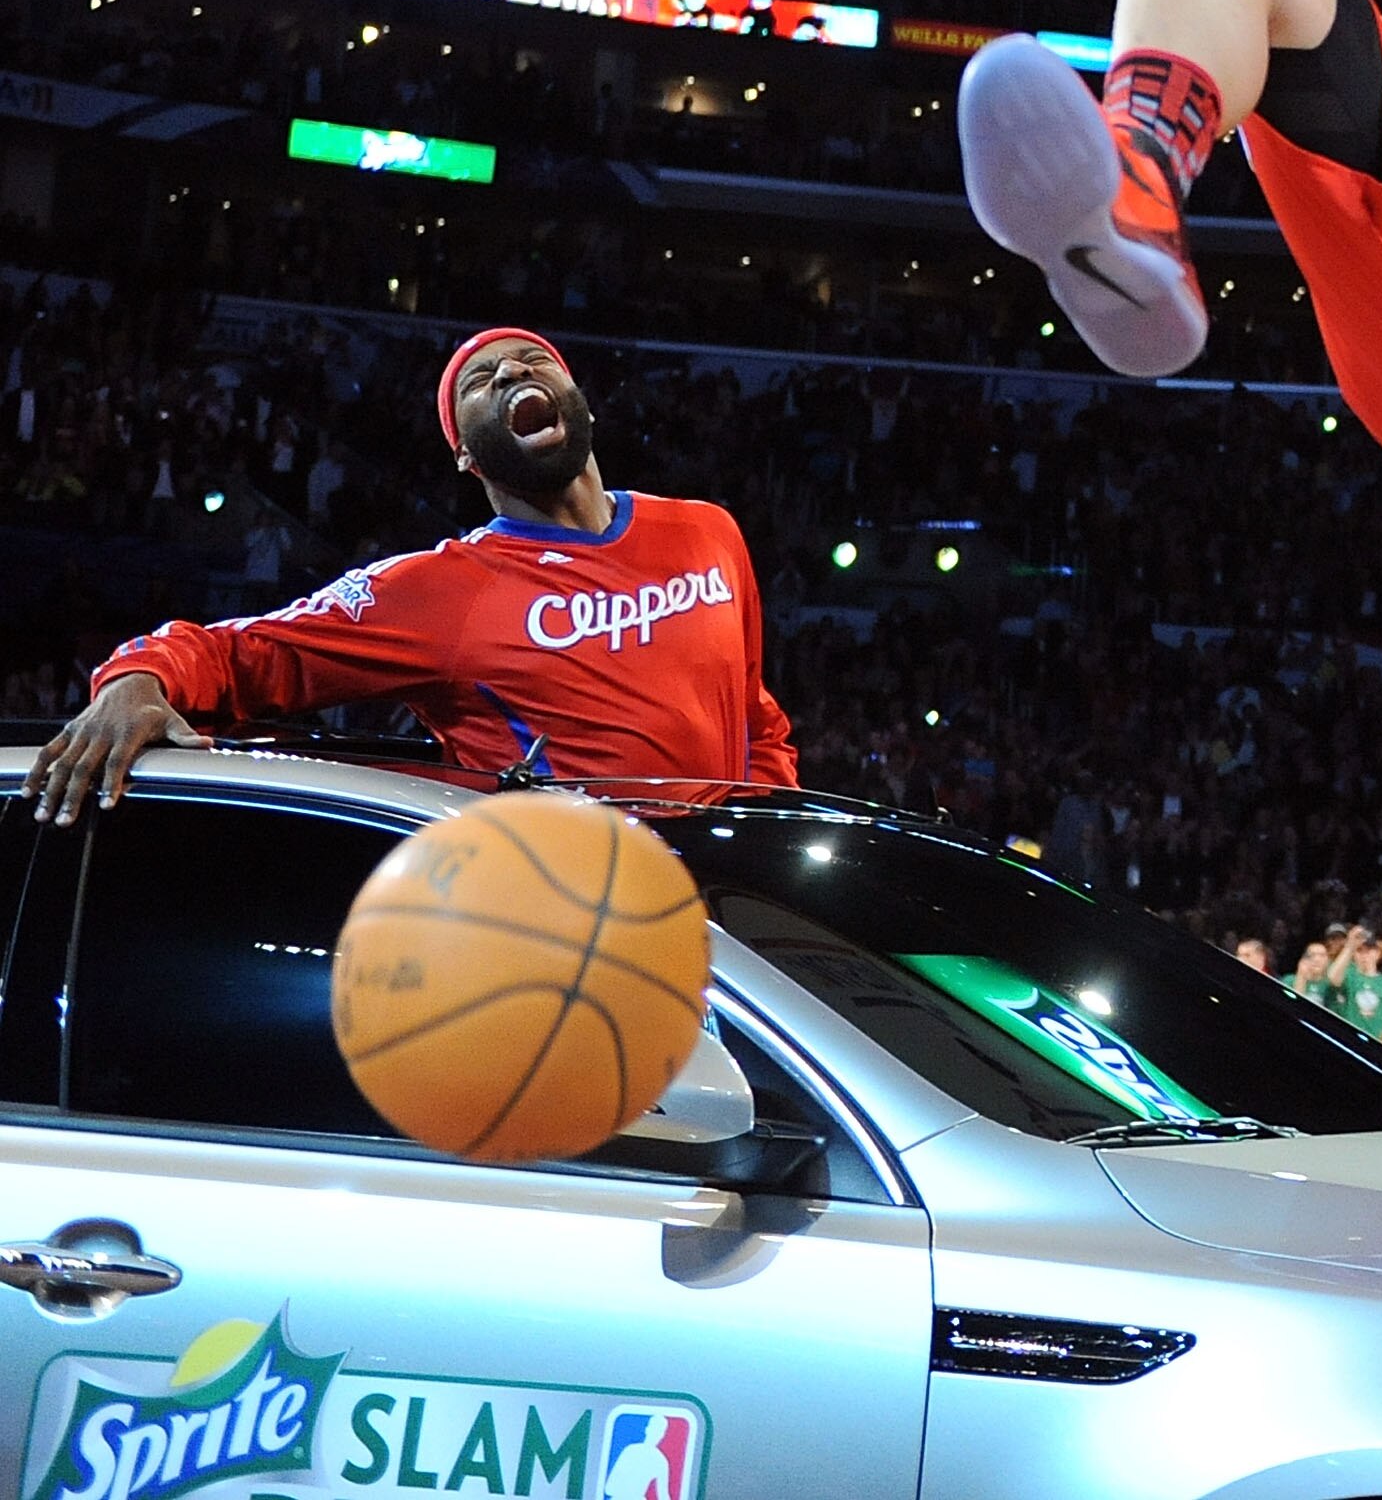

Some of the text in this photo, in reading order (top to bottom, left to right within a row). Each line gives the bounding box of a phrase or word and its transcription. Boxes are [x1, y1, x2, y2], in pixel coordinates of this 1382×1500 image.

[893, 25, 959, 47] WELLS
[527, 566, 733, 651] Clippers
[62, 1350, 307, 1500] Sprite
[340, 1392, 593, 1500] SLAM
